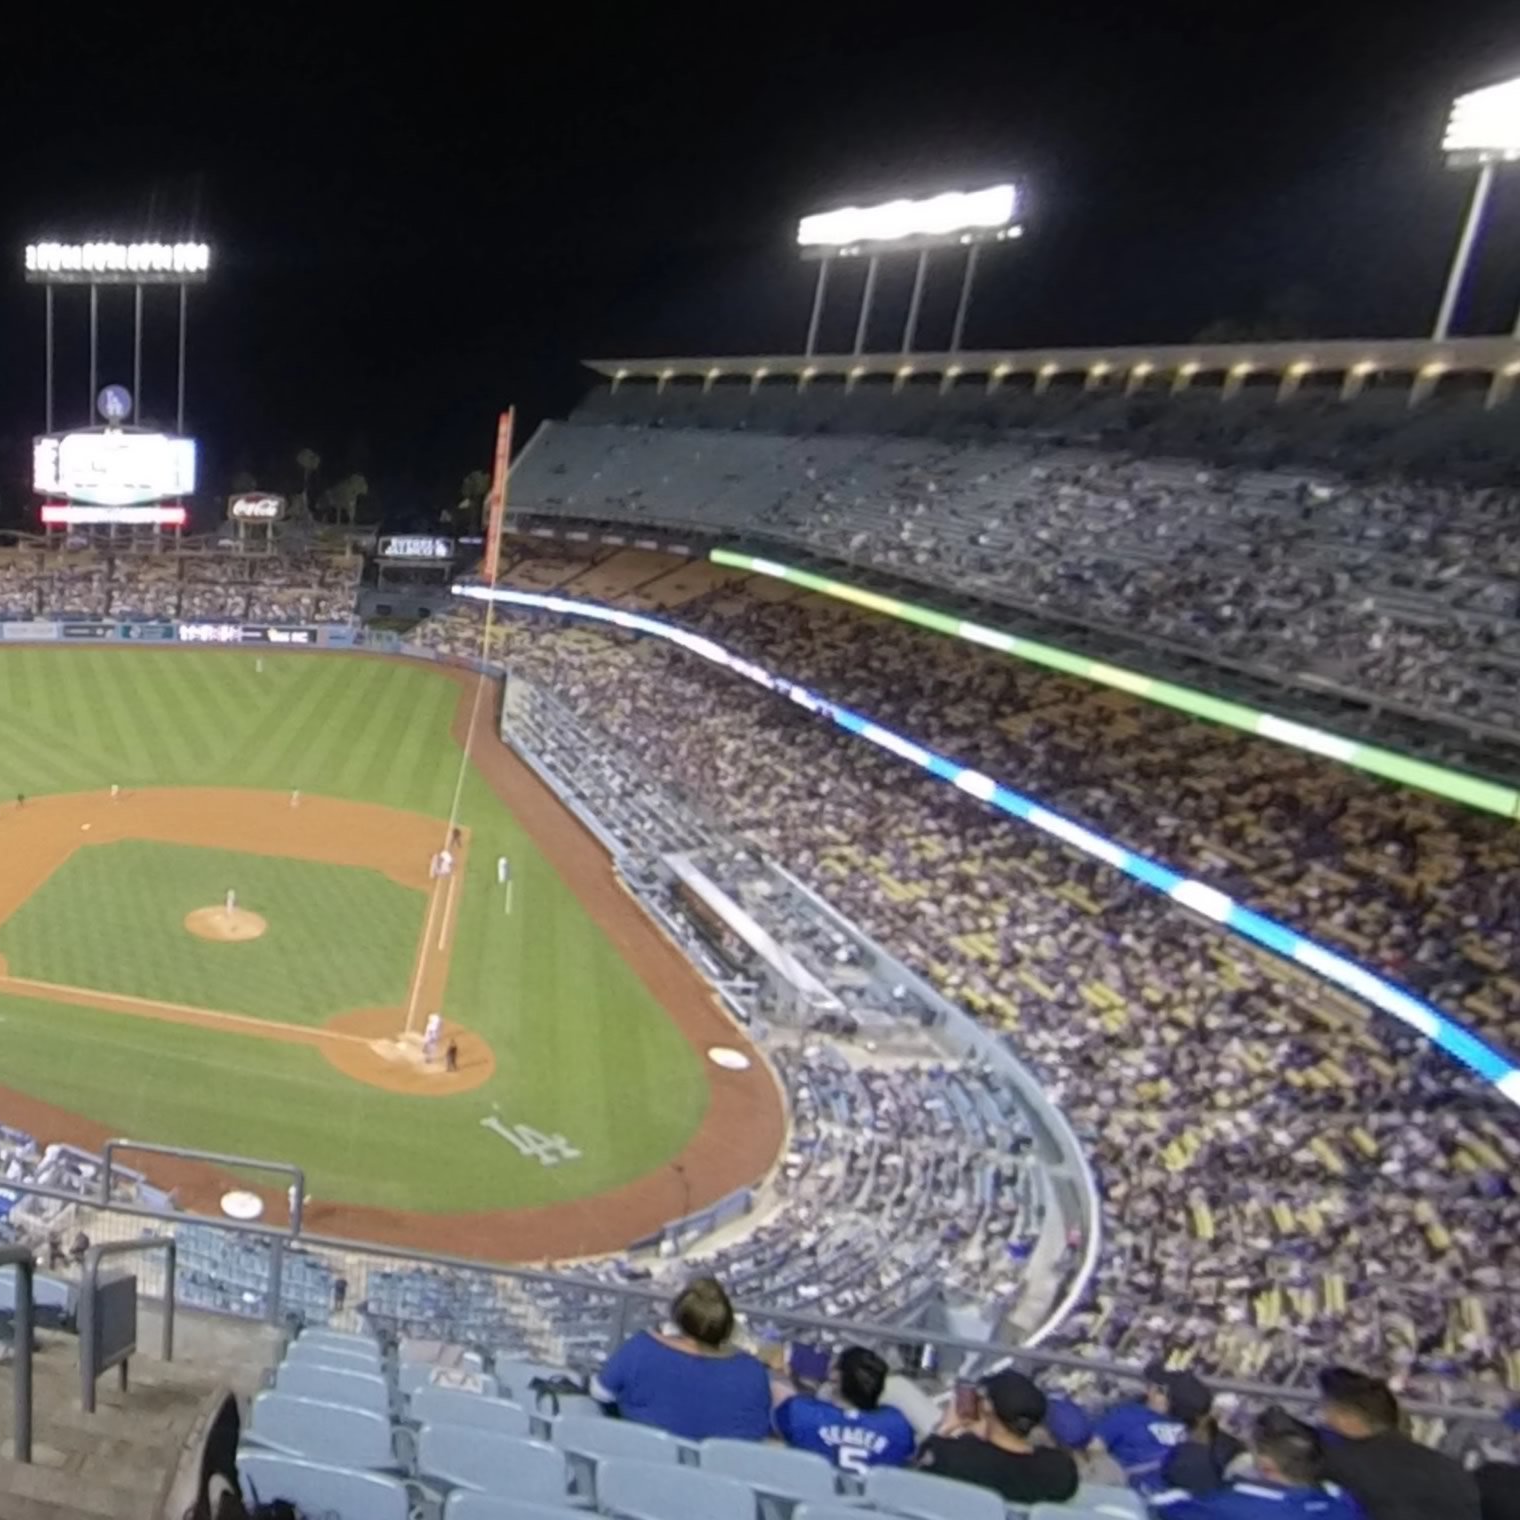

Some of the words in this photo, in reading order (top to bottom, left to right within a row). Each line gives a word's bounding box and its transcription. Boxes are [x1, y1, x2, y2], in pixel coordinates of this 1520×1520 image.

[480, 1116, 583, 1166] LA
[818, 1425, 888, 1455] SEAGER
[839, 1445, 870, 1475] 5
